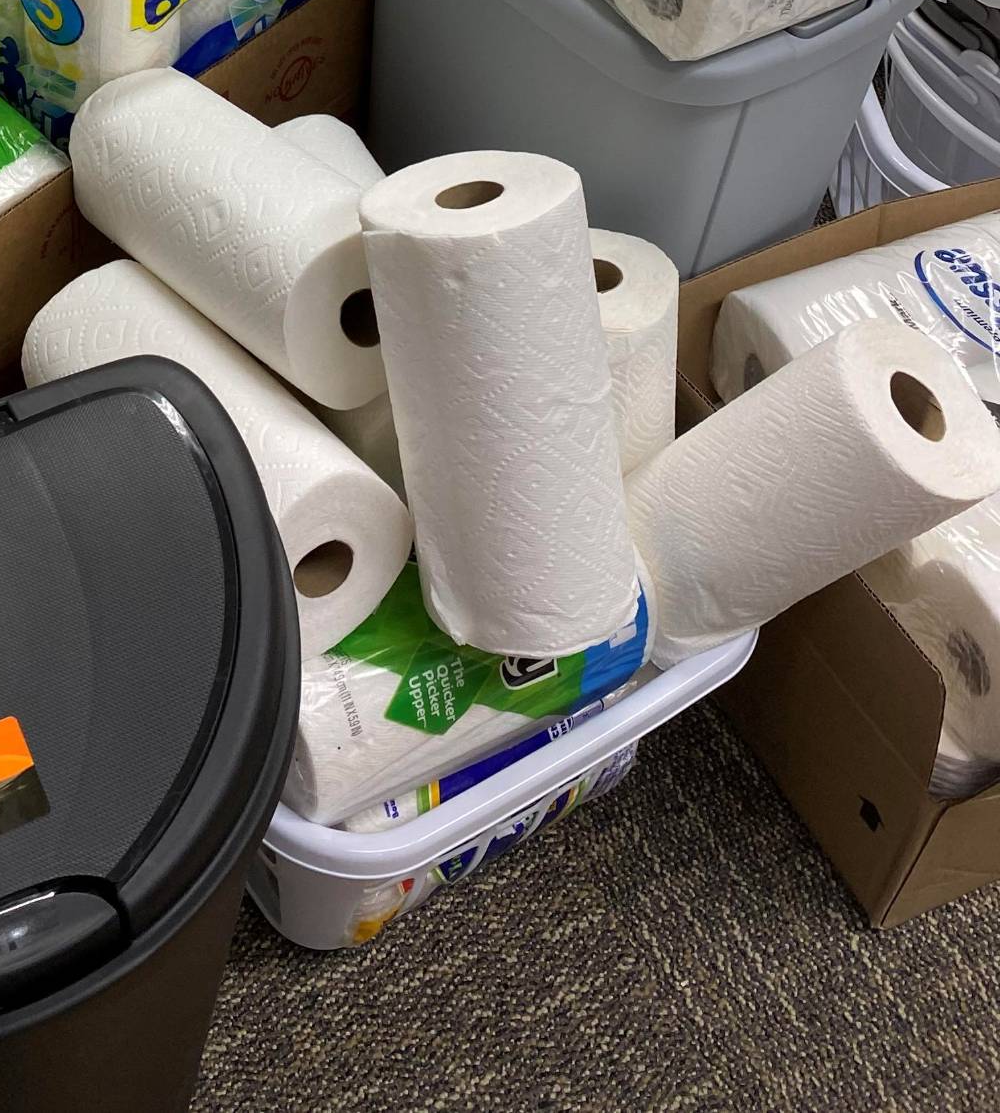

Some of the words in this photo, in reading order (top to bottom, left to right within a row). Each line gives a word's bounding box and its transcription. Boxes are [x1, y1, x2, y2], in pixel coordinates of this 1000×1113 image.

[422, 670, 440, 717] Picker
[436, 664, 457, 722] Quicker
[450, 656, 465, 688] The
[408, 676, 427, 728] Upper
